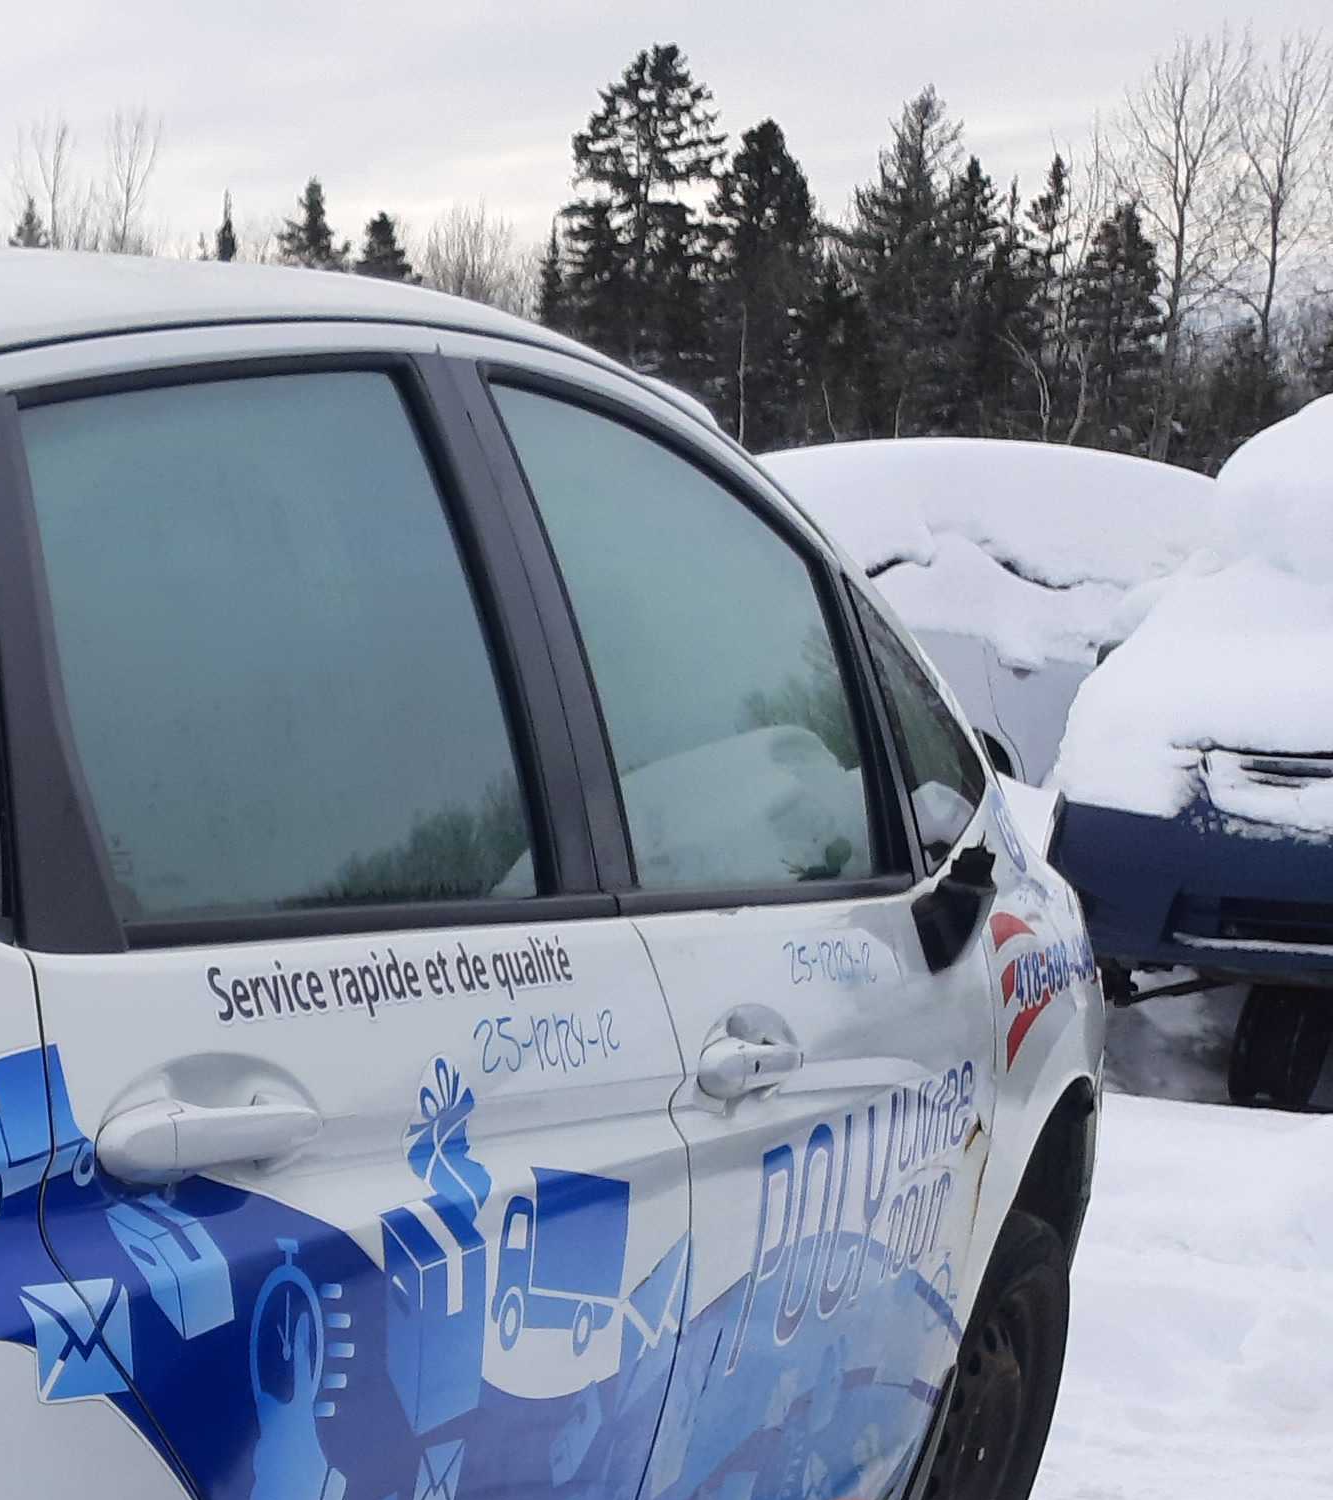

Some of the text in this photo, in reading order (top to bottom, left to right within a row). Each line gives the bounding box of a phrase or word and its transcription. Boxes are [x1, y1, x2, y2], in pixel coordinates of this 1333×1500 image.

[207, 935, 573, 1021] Service rapide et de qualité
[725, 1091, 896, 1375] POLY
[882, 1171, 952, 1279] TOUT
